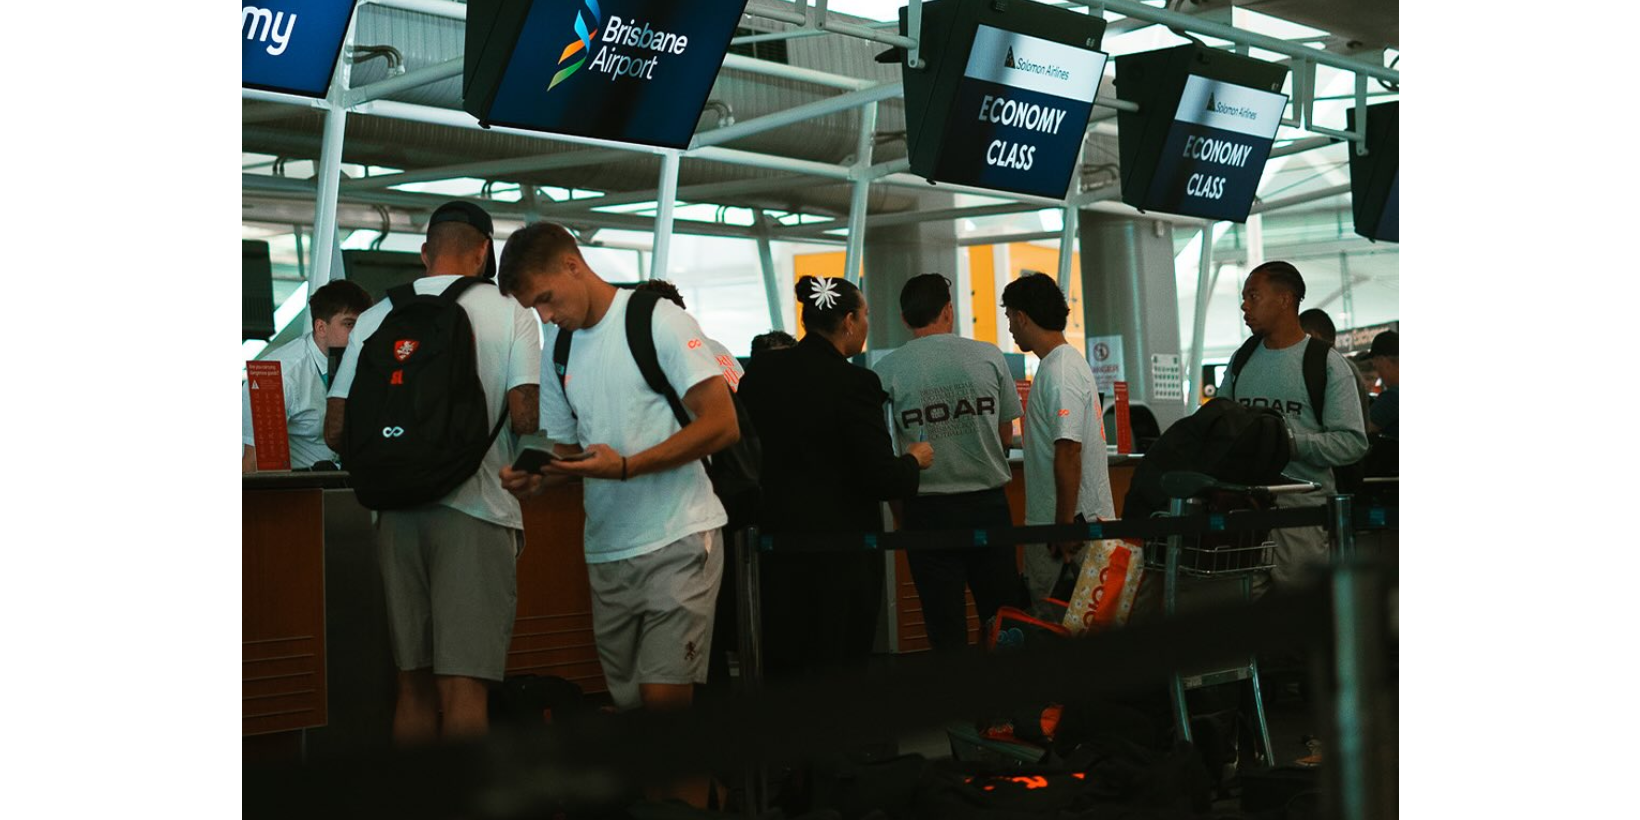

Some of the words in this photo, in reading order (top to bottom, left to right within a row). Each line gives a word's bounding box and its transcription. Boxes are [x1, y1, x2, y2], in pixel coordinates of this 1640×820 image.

[602, 15, 688, 54] Brisbane
[588, 45, 658, 81] Airport
[1016, 57, 1045, 74] Solomon
[1045, 65, 1070, 80] Airlines
[979, 95, 1066, 134] ECONOMY
[1216, 101, 1238, 115] Solomon
[1239, 107, 1257, 120] Airlines
[987, 139, 1036, 171] CLASS
[1183, 135, 1252, 167] ECONOMY
[1187, 173, 1226, 199] CLASS
[901, 397, 995, 429] ROAR
